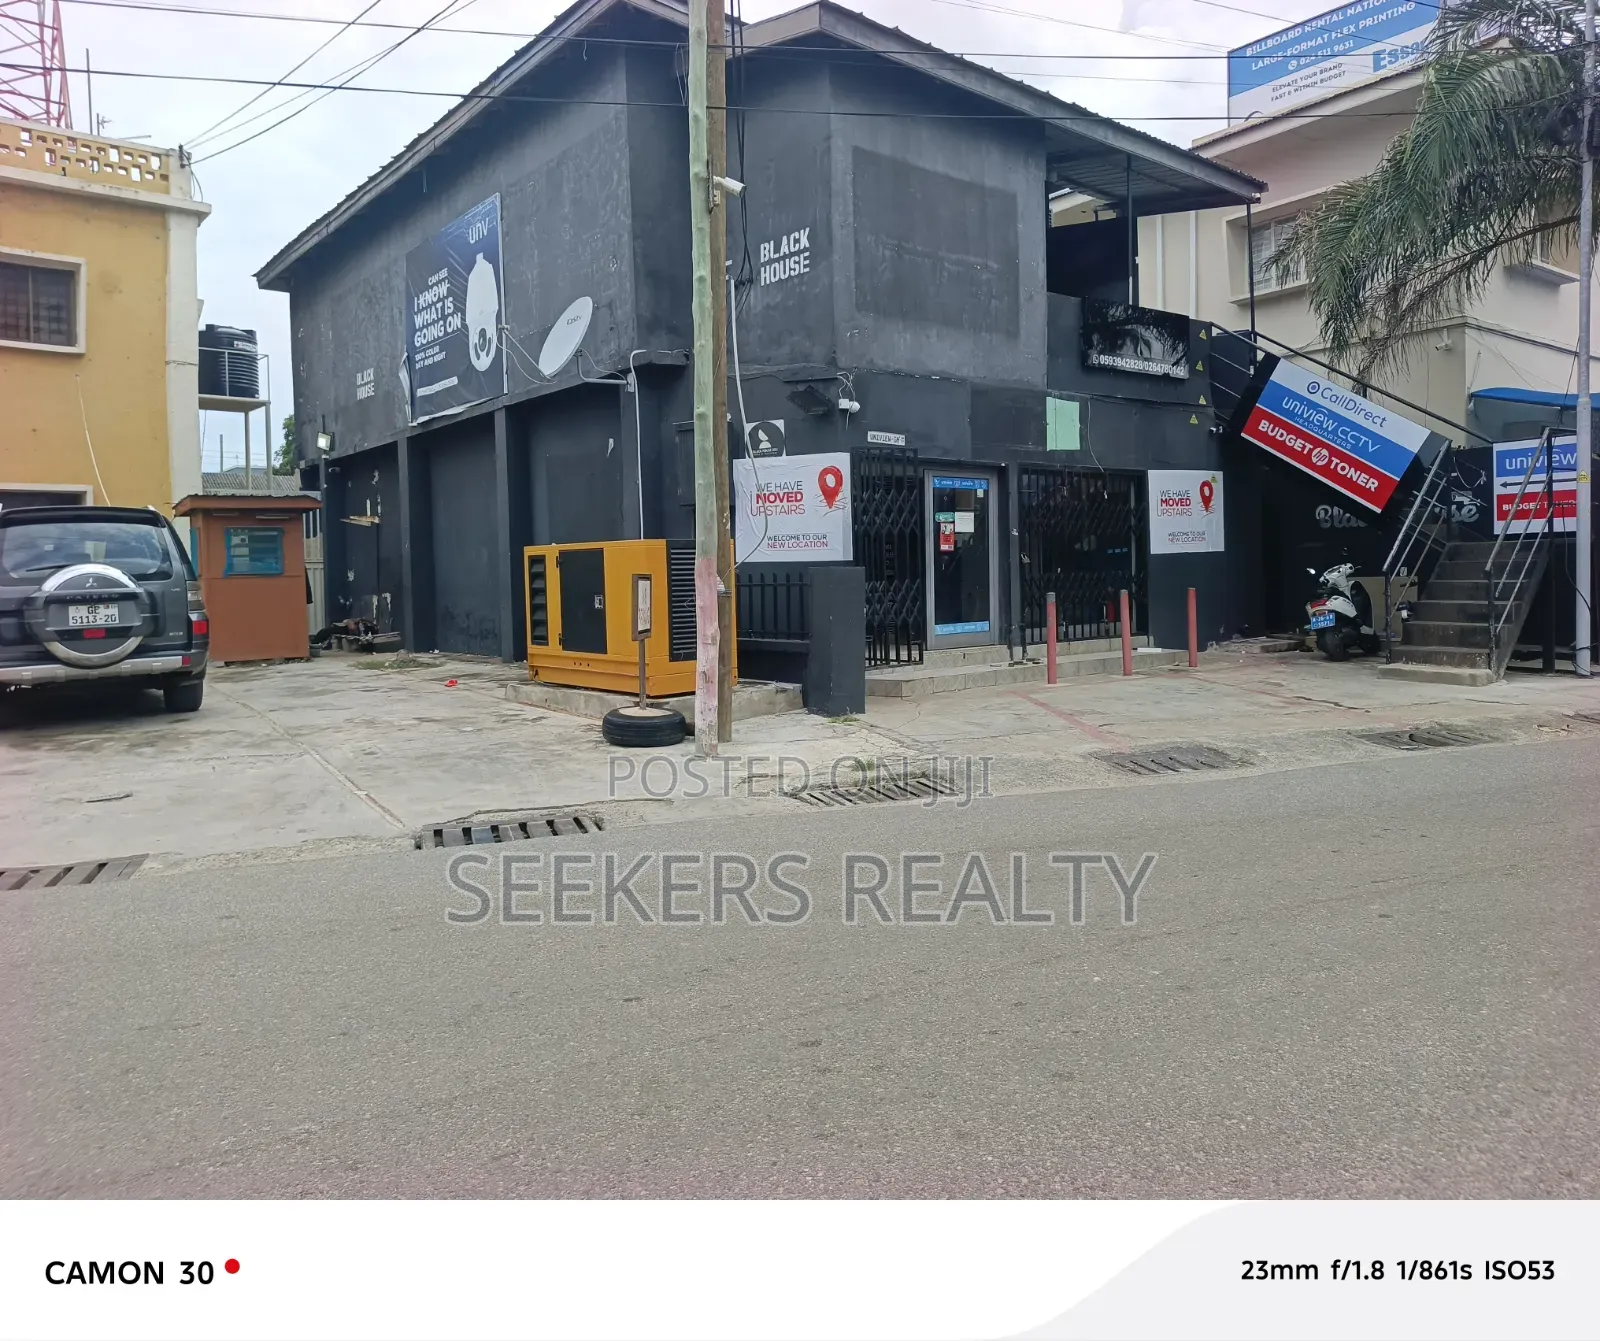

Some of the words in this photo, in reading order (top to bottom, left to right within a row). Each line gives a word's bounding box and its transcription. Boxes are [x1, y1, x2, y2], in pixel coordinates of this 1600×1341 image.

[1246, 28, 1302, 56] BILLBOARD
[1305, 11, 1344, 33] RENTAL
[1252, 33, 1329, 70] LARGE-FORMAT
[1332, 24, 1356, 39] FLEX
[1359, 2, 1416, 29] PRINTING
[1333, 40, 1354, 53] 9631
[1271, 92, 1286, 102] FAST
[1294, 81, 1318, 93] WITHIN
[1320, 71, 1346, 84] BUDGET
[1272, 79, 1298, 92] ELEVATE
[1300, 71, 1317, 81] YOUR
[1320, 62, 1343, 75] BRAND
[760, 227, 810, 263] BLACK
[428, 273, 439, 286] CAN
[439, 267, 448, 280] SEE
[760, 251, 810, 286] HOUSE
[414, 296, 418, 312] I
[419, 279, 450, 310] KNOW
[414, 301, 443, 330] WHAT
[444, 296, 454, 315] IS
[414, 320, 445, 347] GOING
[446, 312, 462, 333] ON
[356, 367, 374, 386] BLACK
[424, 357, 433, 366] AND
[356, 382, 375, 400] HOUSE
[1320, 387, 1388, 428] CallDirect
[1282, 396, 1338, 432] uniview
[1338, 426, 1381, 453] CCTV
[1295, 416, 1352, 450] HEADQUARTERS
[1258, 419, 1313, 455] BUDGET
[1330, 457, 1379, 492] TONER
[755, 482, 772, 492] WE
[774, 481, 803, 491] HAVE
[756, 491, 804, 504] MOVED
[750, 494, 806, 516] UPSTAIRS
[1157, 499, 1192, 517] UPSTAIRS
[1160, 498, 1191, 507] MOVED
[72, 614, 117, 625] 5113-20
[87, 605, 101, 615] GE
